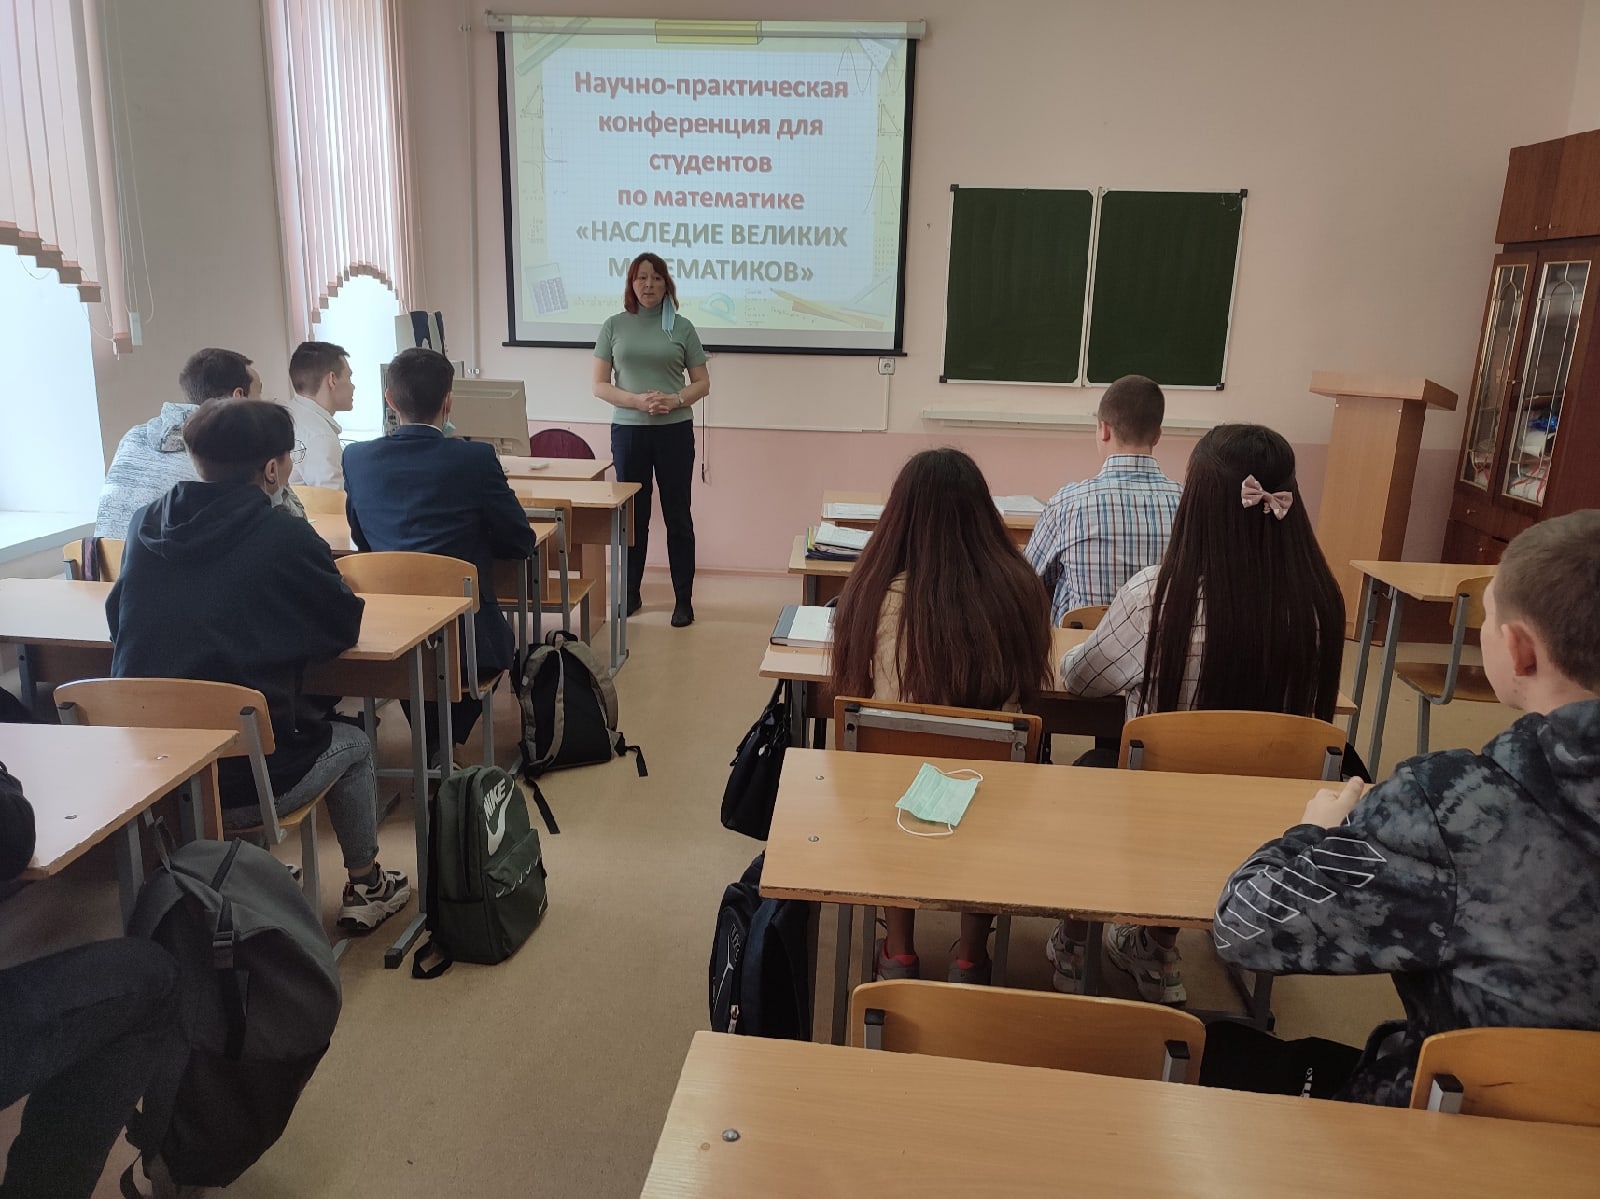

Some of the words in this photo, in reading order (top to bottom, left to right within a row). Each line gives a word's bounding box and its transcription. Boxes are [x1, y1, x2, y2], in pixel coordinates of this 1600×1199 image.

[574, 71, 849, 101] Научно-практическая
[598, 110, 771, 138] конференция
[776, 117, 824, 140] для
[649, 152, 773, 175] студентов
[617, 188, 648, 206] по
[653, 190, 805, 210] математике
[576, 220, 724, 248] «НАСЛЕДИЕ
[731, 223, 849, 247] ВЕЛИКИХ
[608, 257, 814, 282] ММАТИКОВ»
[483, 777, 506, 821] NIKE
